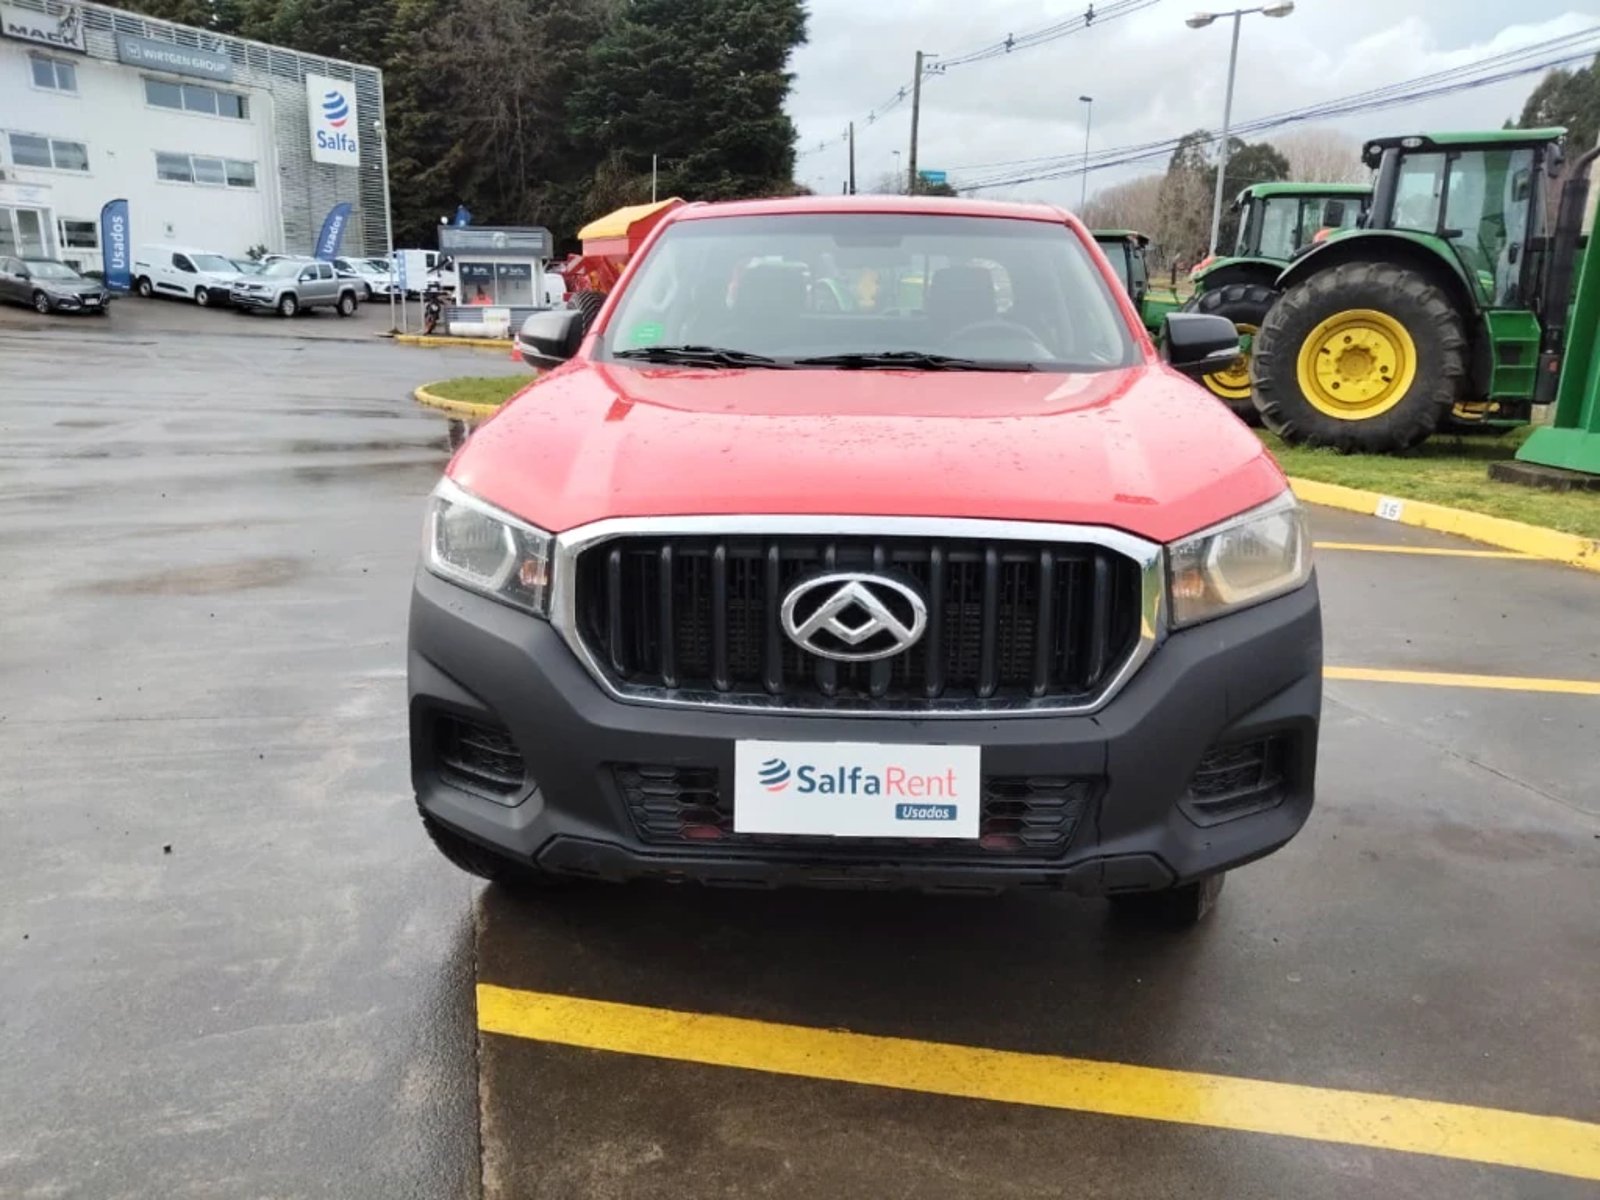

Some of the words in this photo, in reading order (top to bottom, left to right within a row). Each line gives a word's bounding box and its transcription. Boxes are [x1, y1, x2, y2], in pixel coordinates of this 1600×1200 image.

[8, 23, 78, 46] MACK
[143, 49, 191, 66] WIRTGEN
[192, 59, 227, 73] GROUP
[316, 130, 357, 152] Salfa
[110, 215, 125, 269] Usados
[323, 215, 343, 253] Usados
[1381, 502, 1398, 518] 16
[902, 805, 950, 819] Usados
